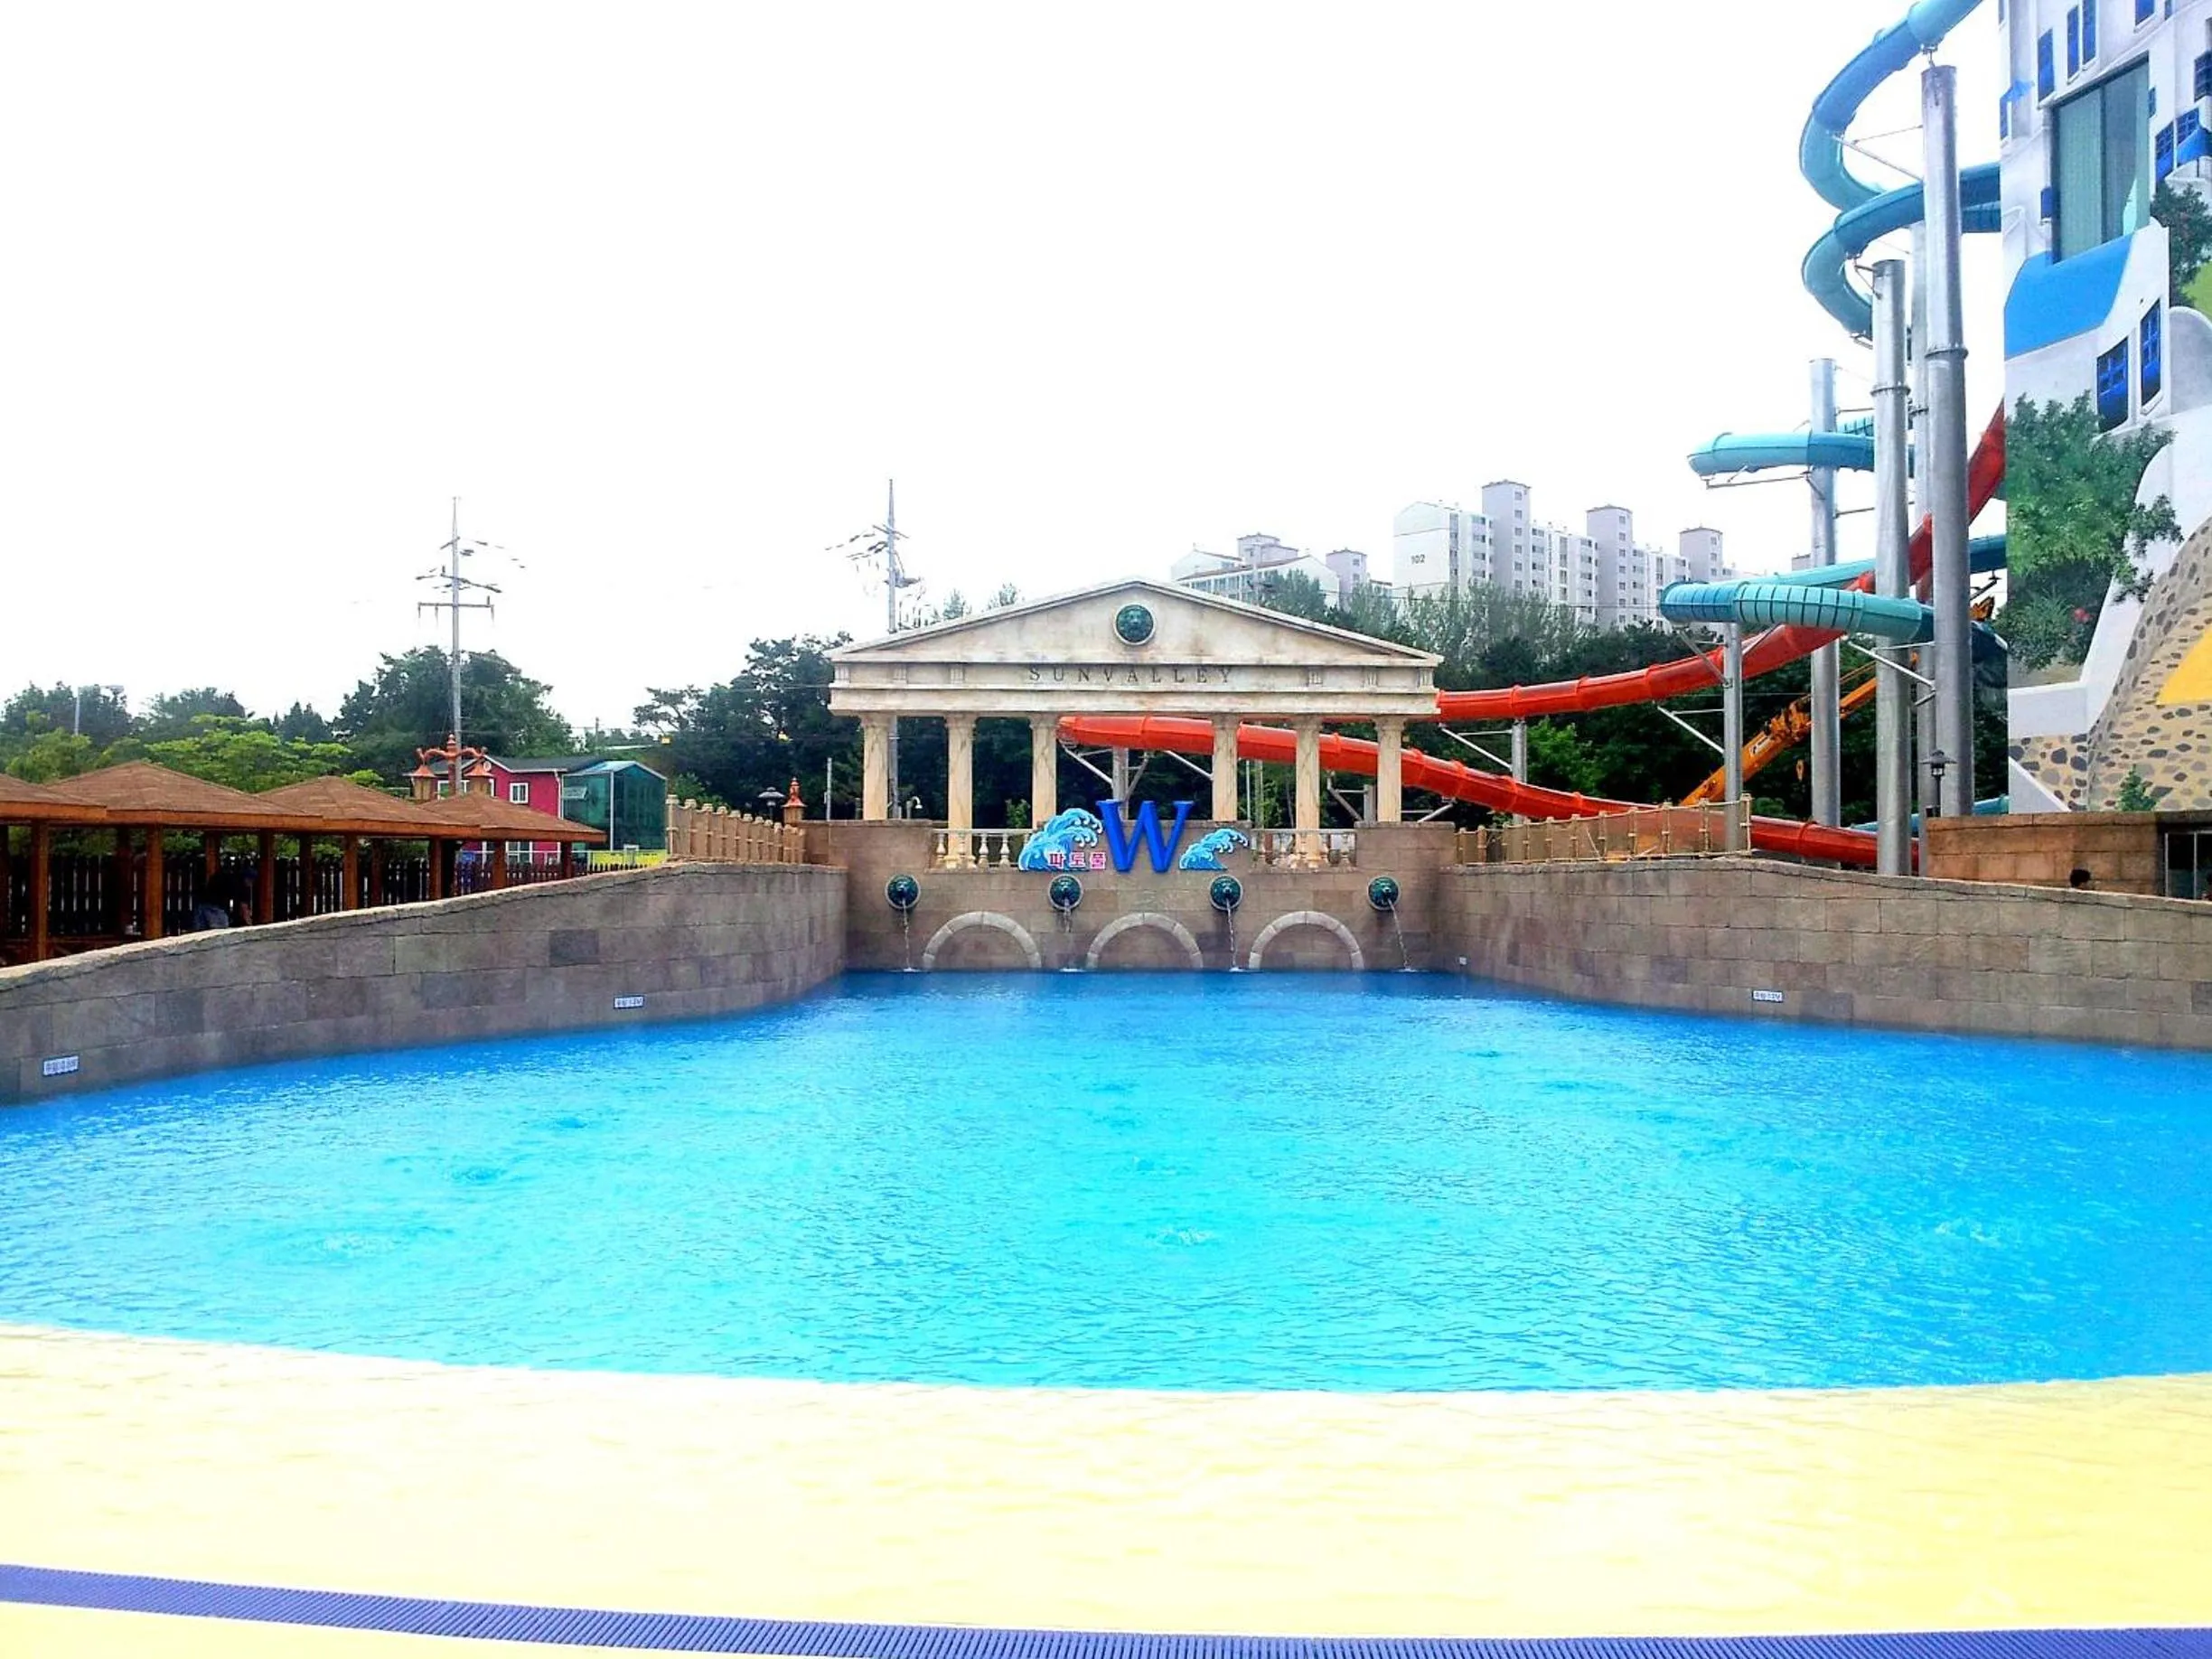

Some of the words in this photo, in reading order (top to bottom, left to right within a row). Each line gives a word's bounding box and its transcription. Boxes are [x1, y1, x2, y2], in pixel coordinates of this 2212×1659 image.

[1411, 553, 1425, 565] 102
[1028, 665, 1233, 683] SUNVALLEY
[1095, 799, 1195, 873] W
[1046, 850, 1106, 869] 파도풀
